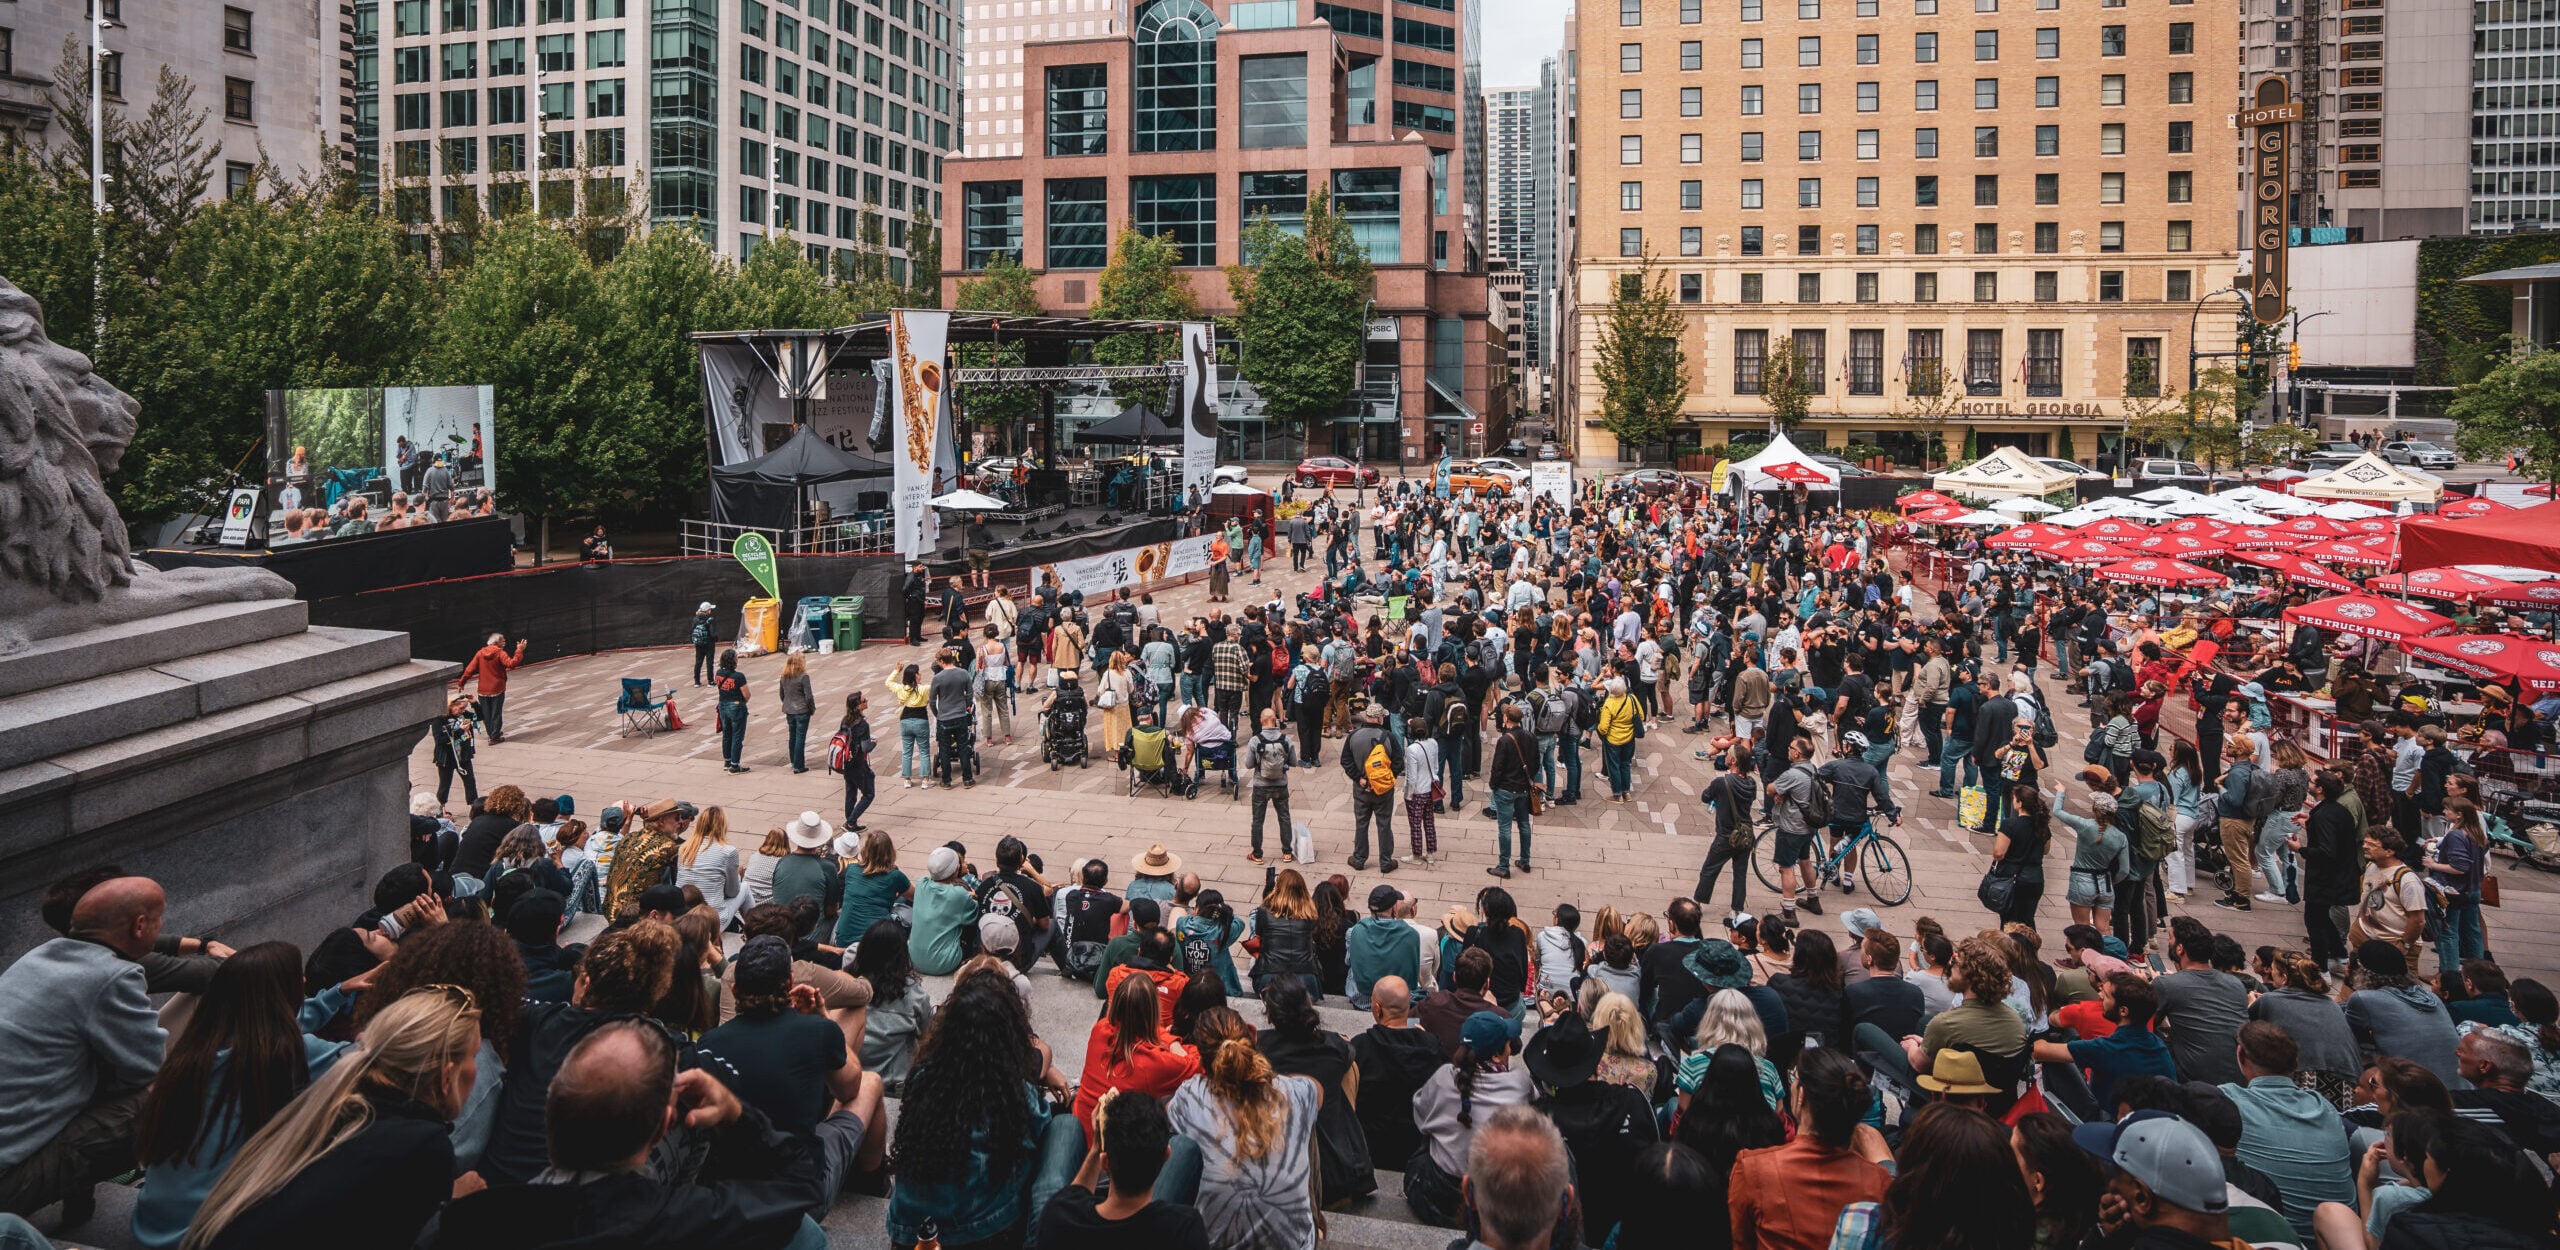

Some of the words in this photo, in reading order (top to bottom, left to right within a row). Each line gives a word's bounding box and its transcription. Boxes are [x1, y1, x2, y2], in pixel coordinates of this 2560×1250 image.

[2244, 108, 2296, 123] HOTEL
[2258, 132, 2282, 298] GEORGIA
[832, 406, 872, 415] FESTIVAL
[1962, 402, 2013, 414] HOTEL
[2026, 402, 2104, 416] GEORGIA
[2333, 555, 2361, 563] TRUCK
[2120, 573, 2145, 581] TRUCK
[2146, 576, 2167, 584] BEER
[2306, 577, 2330, 587] TRUCK
[2331, 582, 2351, 592] BEER
[2398, 584, 2428, 594] TUCK
[2430, 588, 2455, 598] BEER
[2520, 601, 2560, 611] TRUCK
[2298, 616, 2322, 625] RED
[2324, 619, 2364, 633] TRUCK
[2366, 627, 2401, 640] BEER
[2412, 646, 2434, 658] Hand
[2532, 680, 2555, 689] RED
